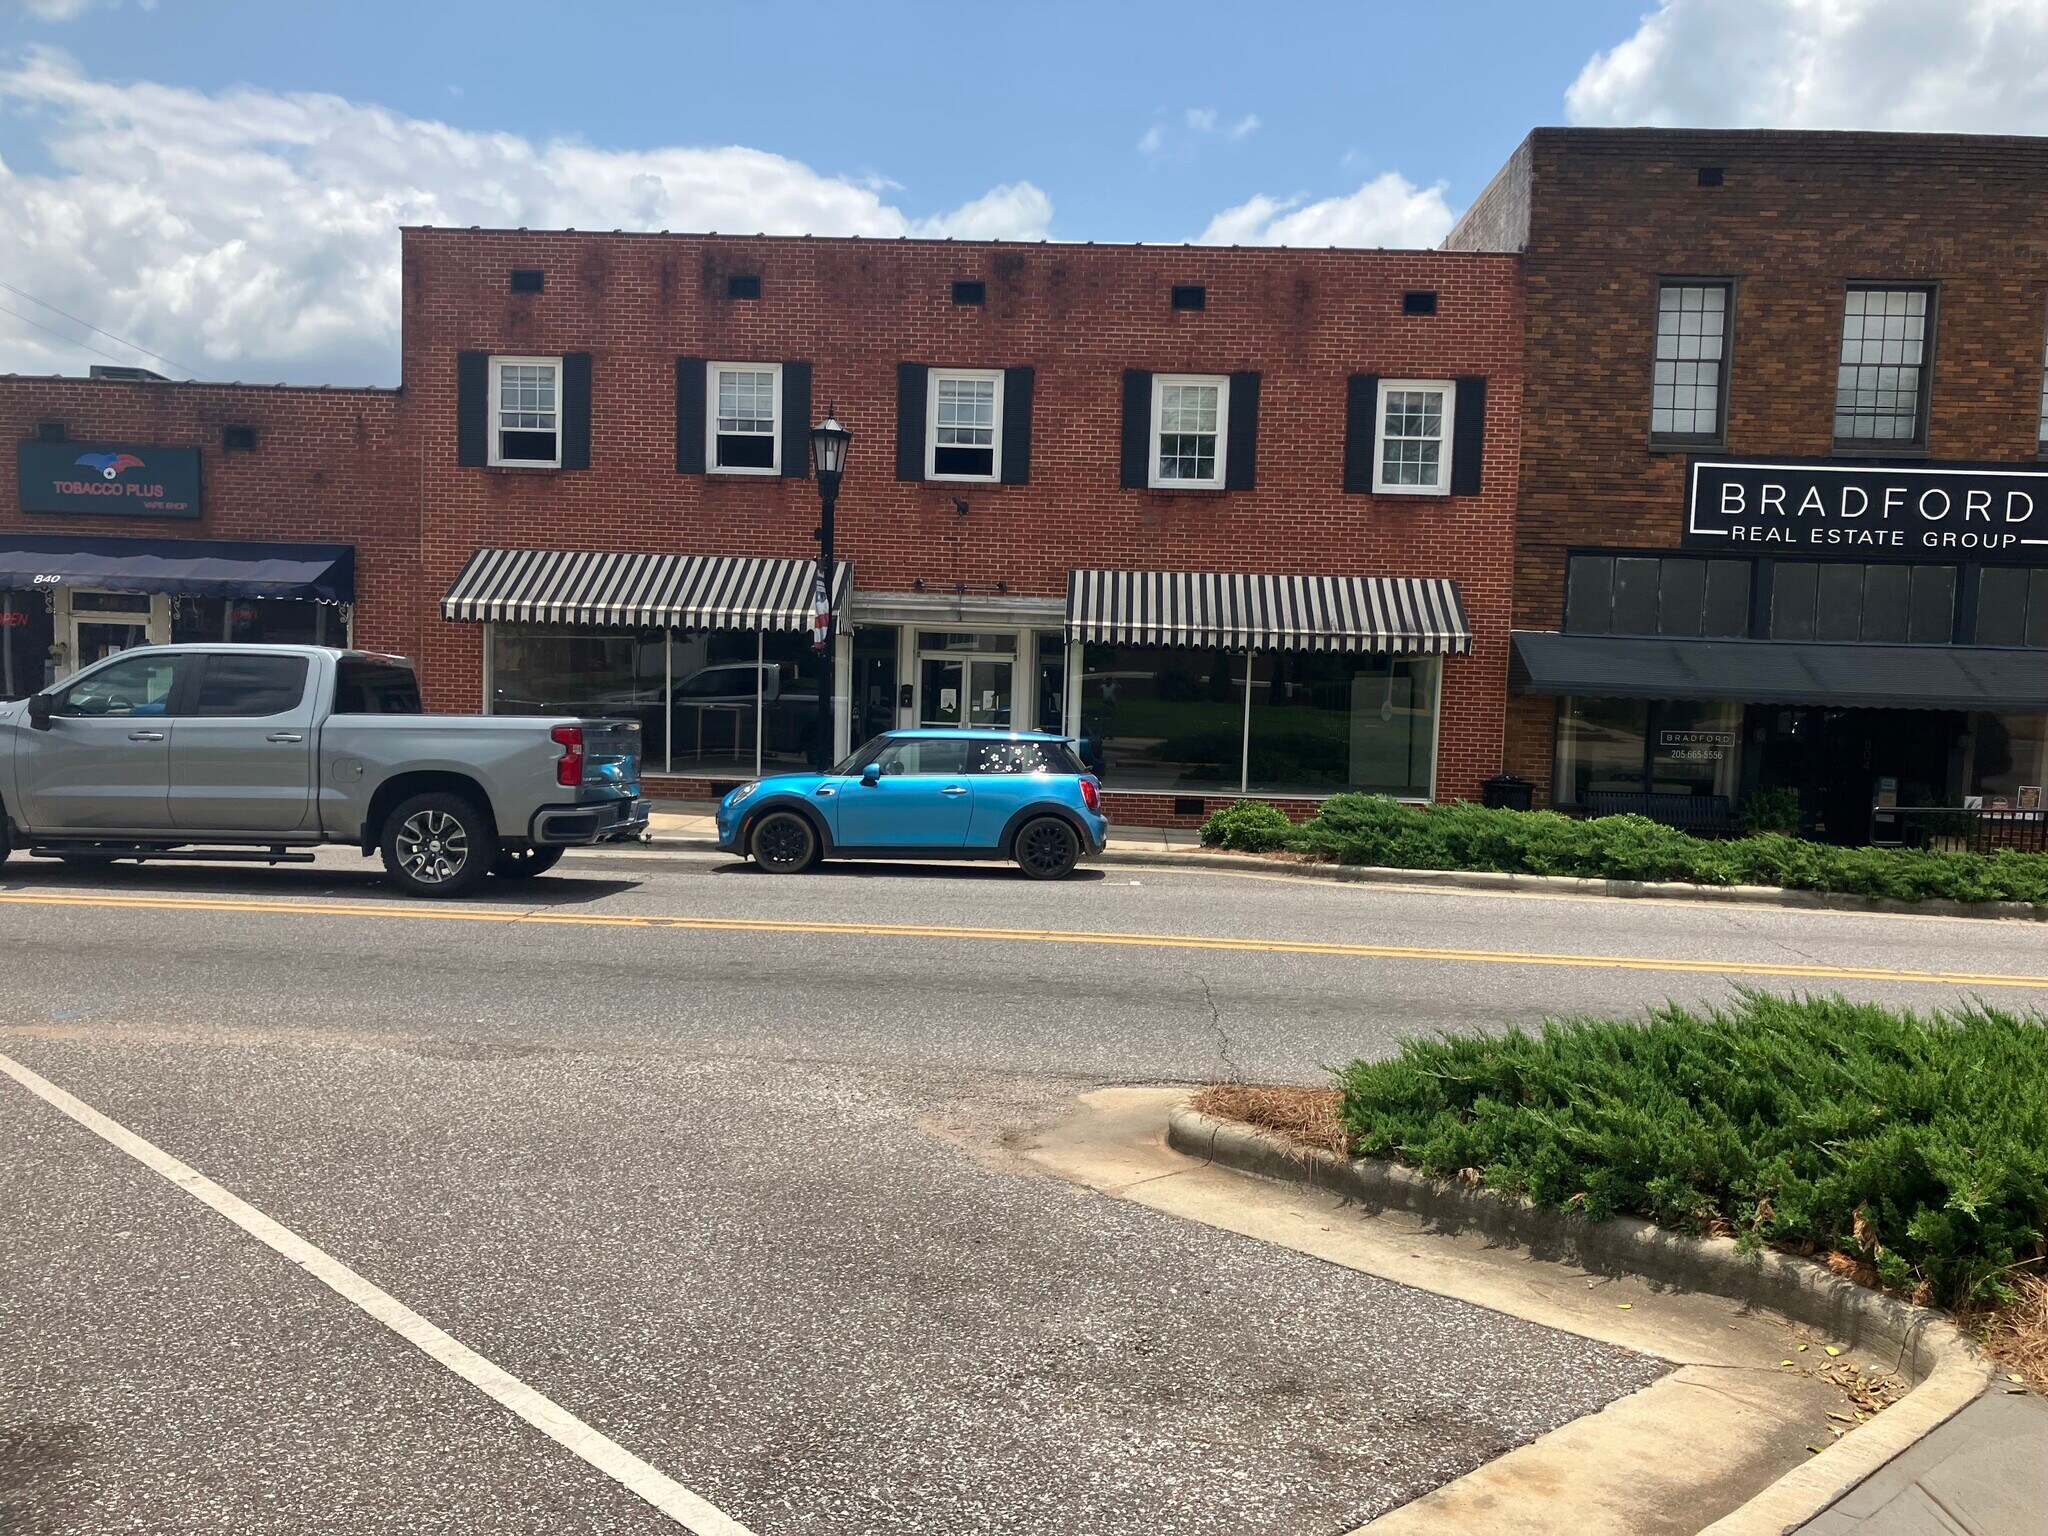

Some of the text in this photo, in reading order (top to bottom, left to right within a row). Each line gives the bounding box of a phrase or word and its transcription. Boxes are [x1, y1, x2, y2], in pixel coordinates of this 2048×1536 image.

[53, 481, 164, 498] TOBACCO PLUS
[143, 501, 188, 510] VAPE SHOP
[1720, 481, 2035, 523] BRADFORD
[1731, 525, 2017, 549] REAL ESTATE GROUP
[33, 574, 61, 584] 840
[1666, 734, 1730, 743] BRADFORD
